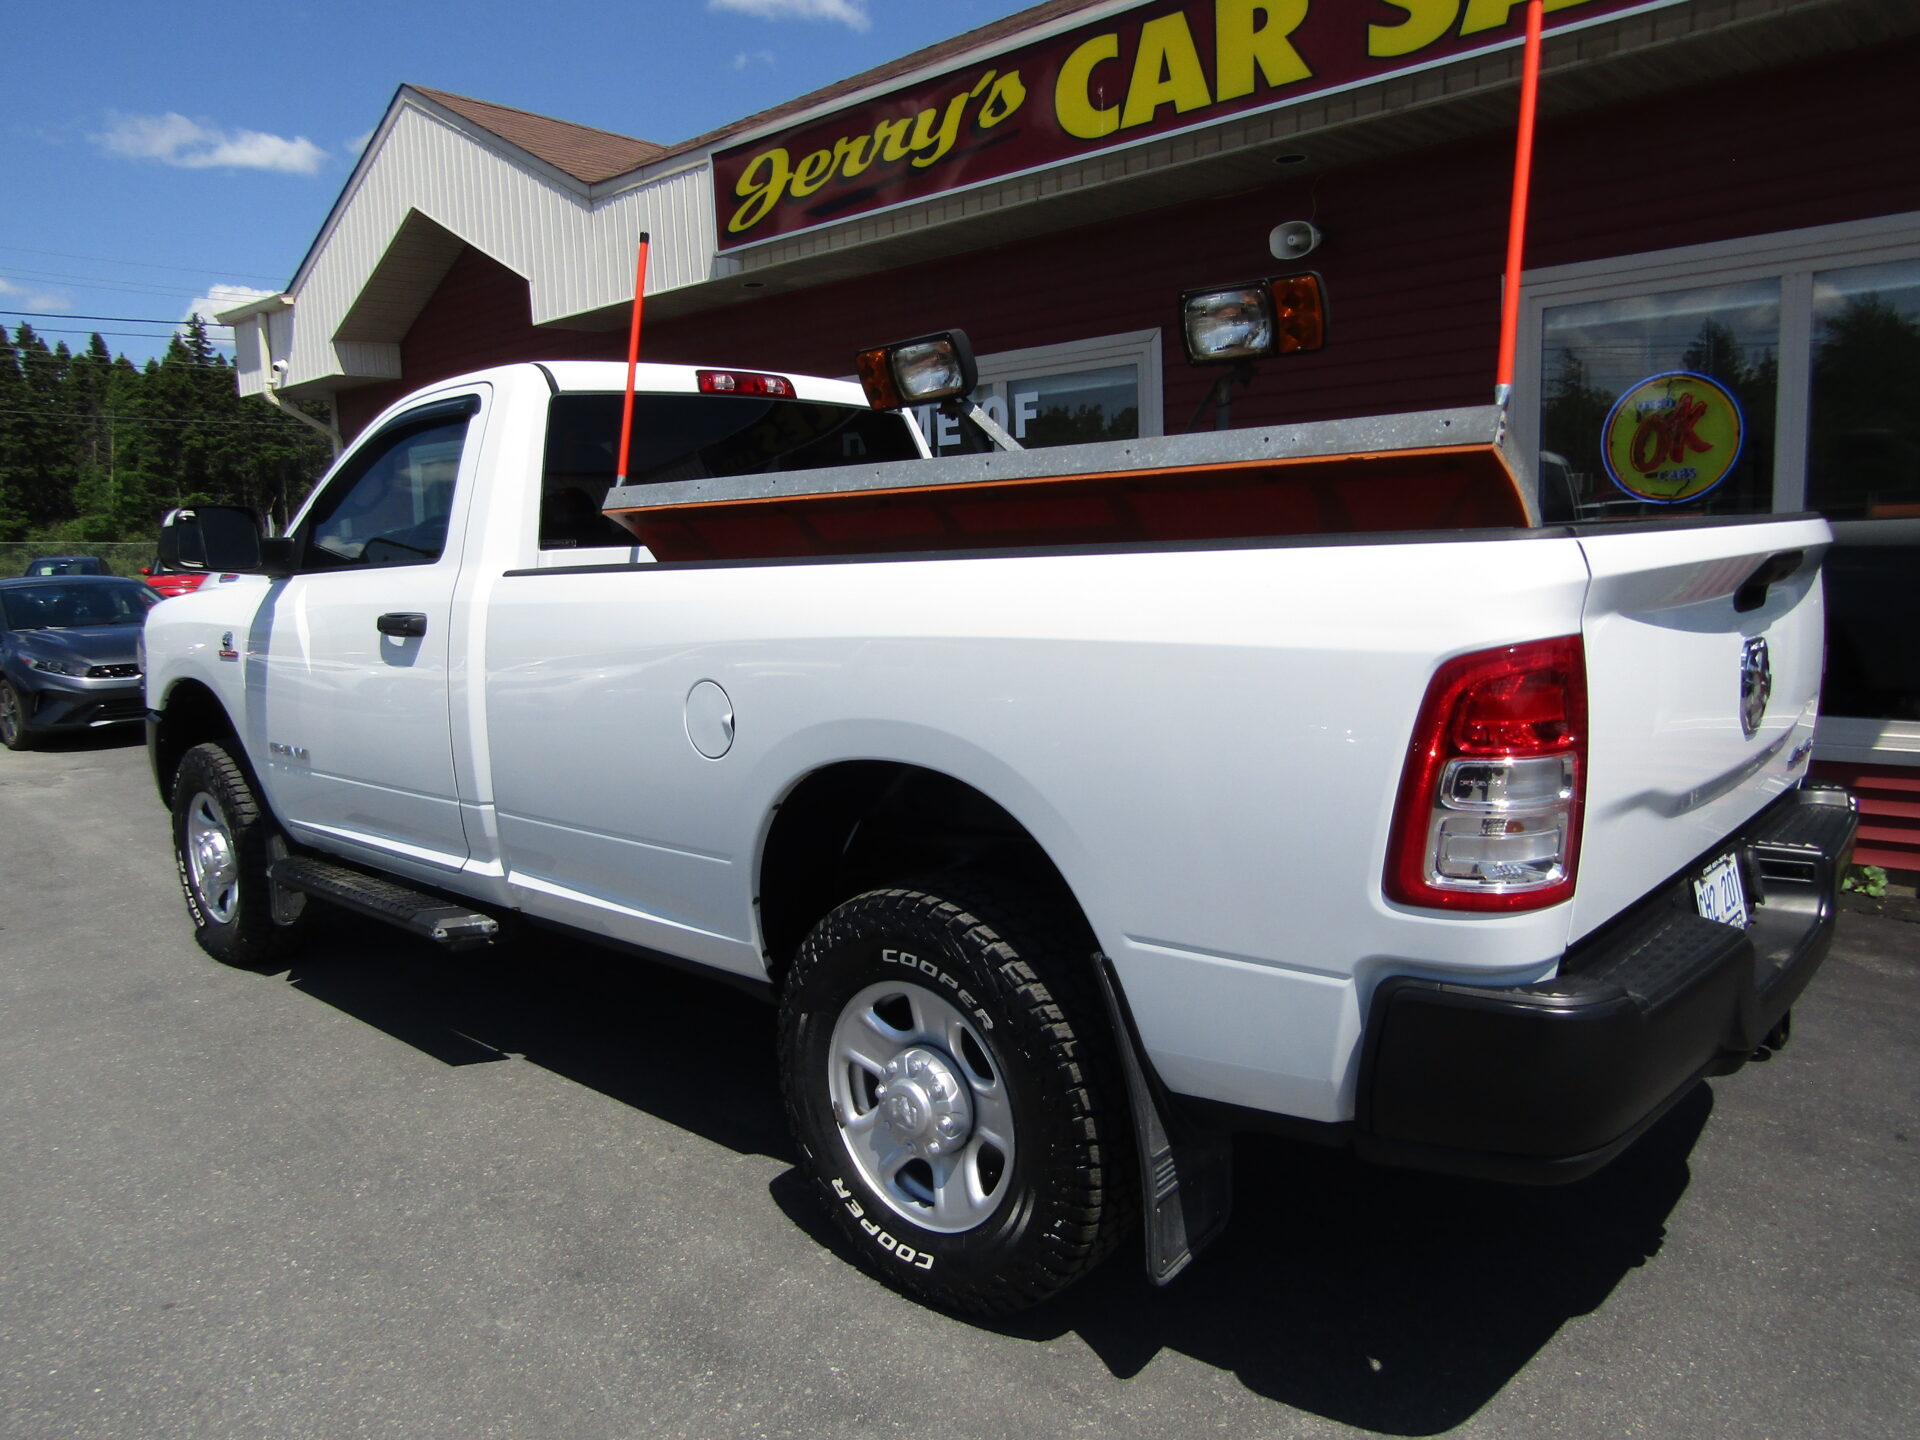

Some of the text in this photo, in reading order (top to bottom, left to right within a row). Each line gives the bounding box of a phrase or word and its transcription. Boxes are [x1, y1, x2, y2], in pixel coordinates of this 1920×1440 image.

[728, 0, 1313, 233] Jerry's CAR
[1630, 392, 1715, 473] OK
[1720, 866, 1742, 912] 201
[882, 949, 994, 1031] COOPER
[831, 1177, 935, 1271] COOPER
